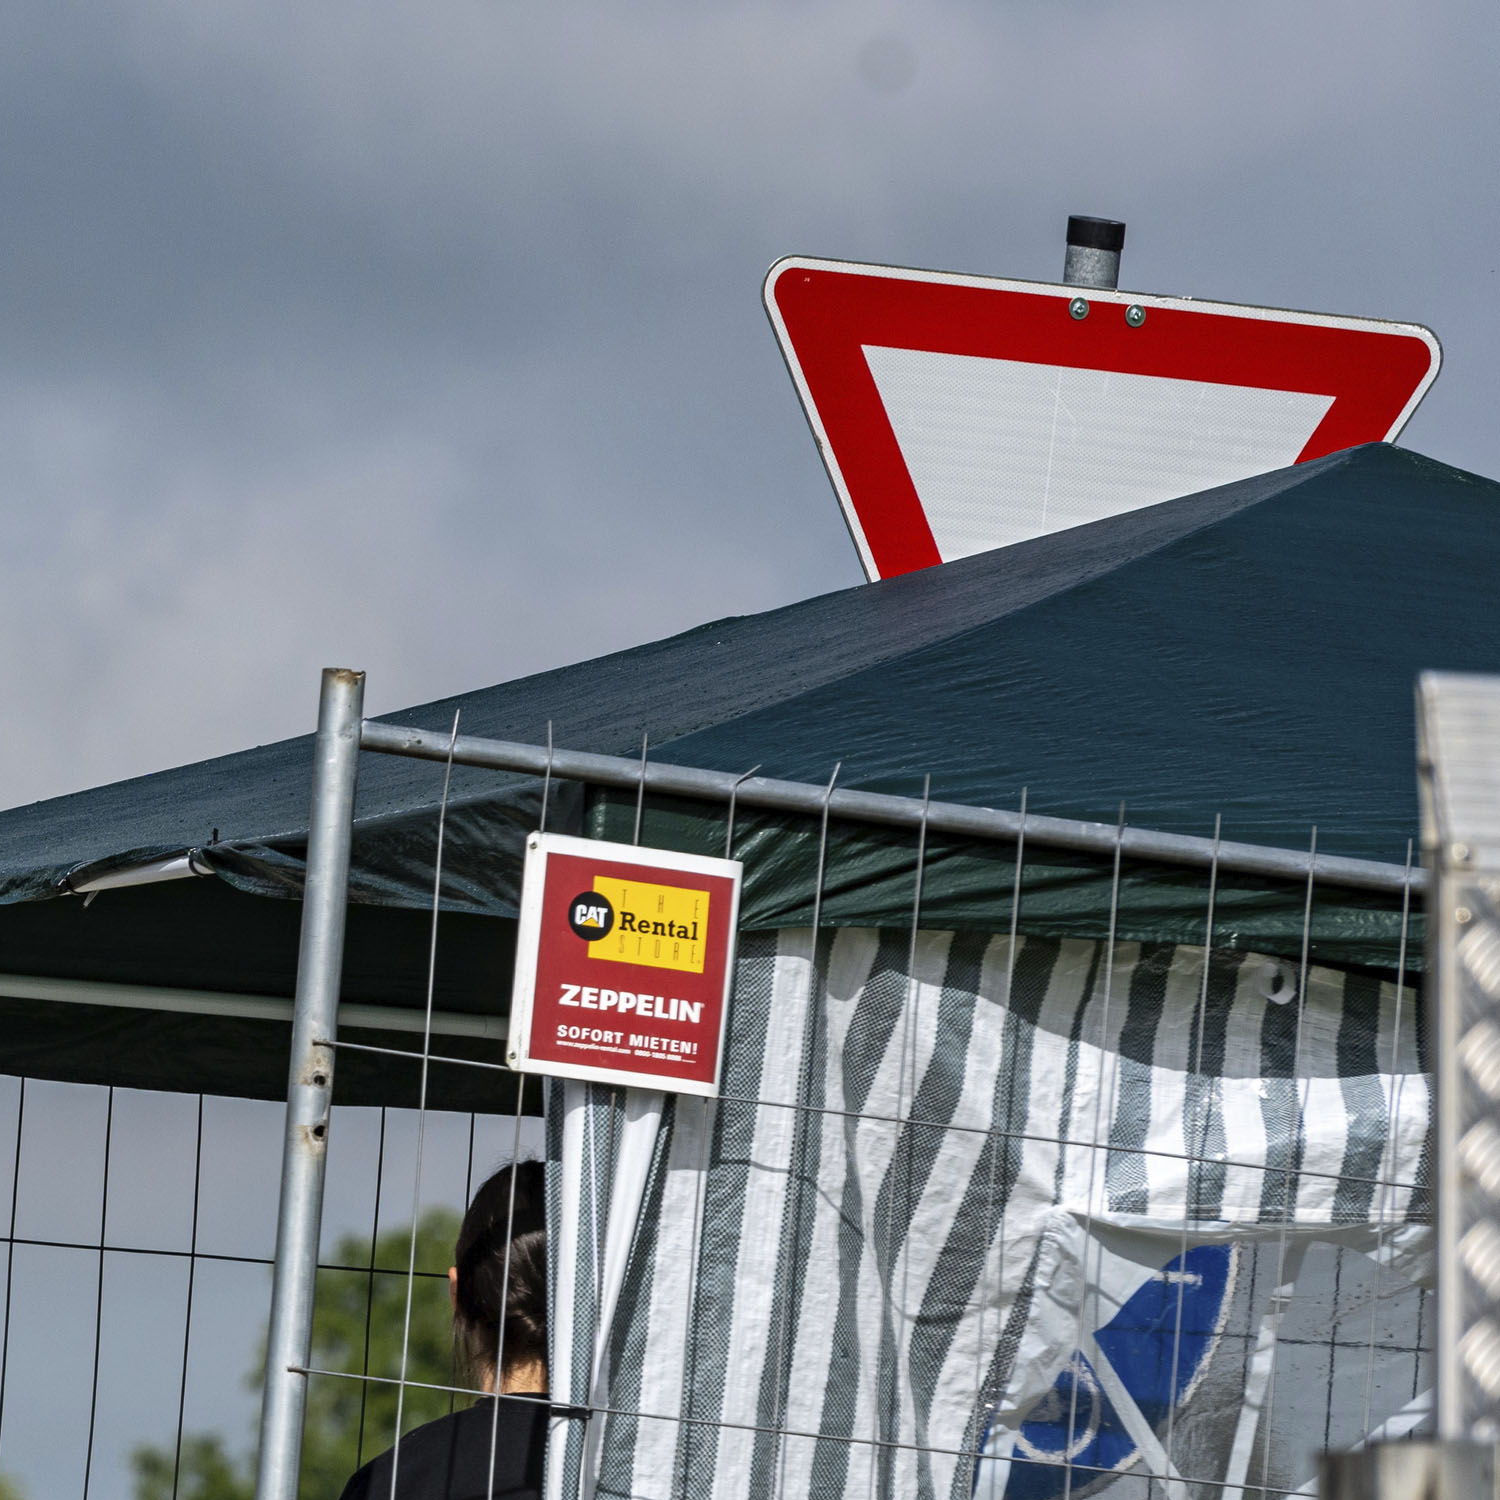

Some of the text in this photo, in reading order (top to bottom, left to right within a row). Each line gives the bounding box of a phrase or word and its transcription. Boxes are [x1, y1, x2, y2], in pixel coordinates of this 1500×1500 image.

[574, 904, 698, 940] CAT Rental
[558, 983, 701, 1024] ZEPPELIN
[556, 1024, 698, 1055] SOFORT MIETEN!
